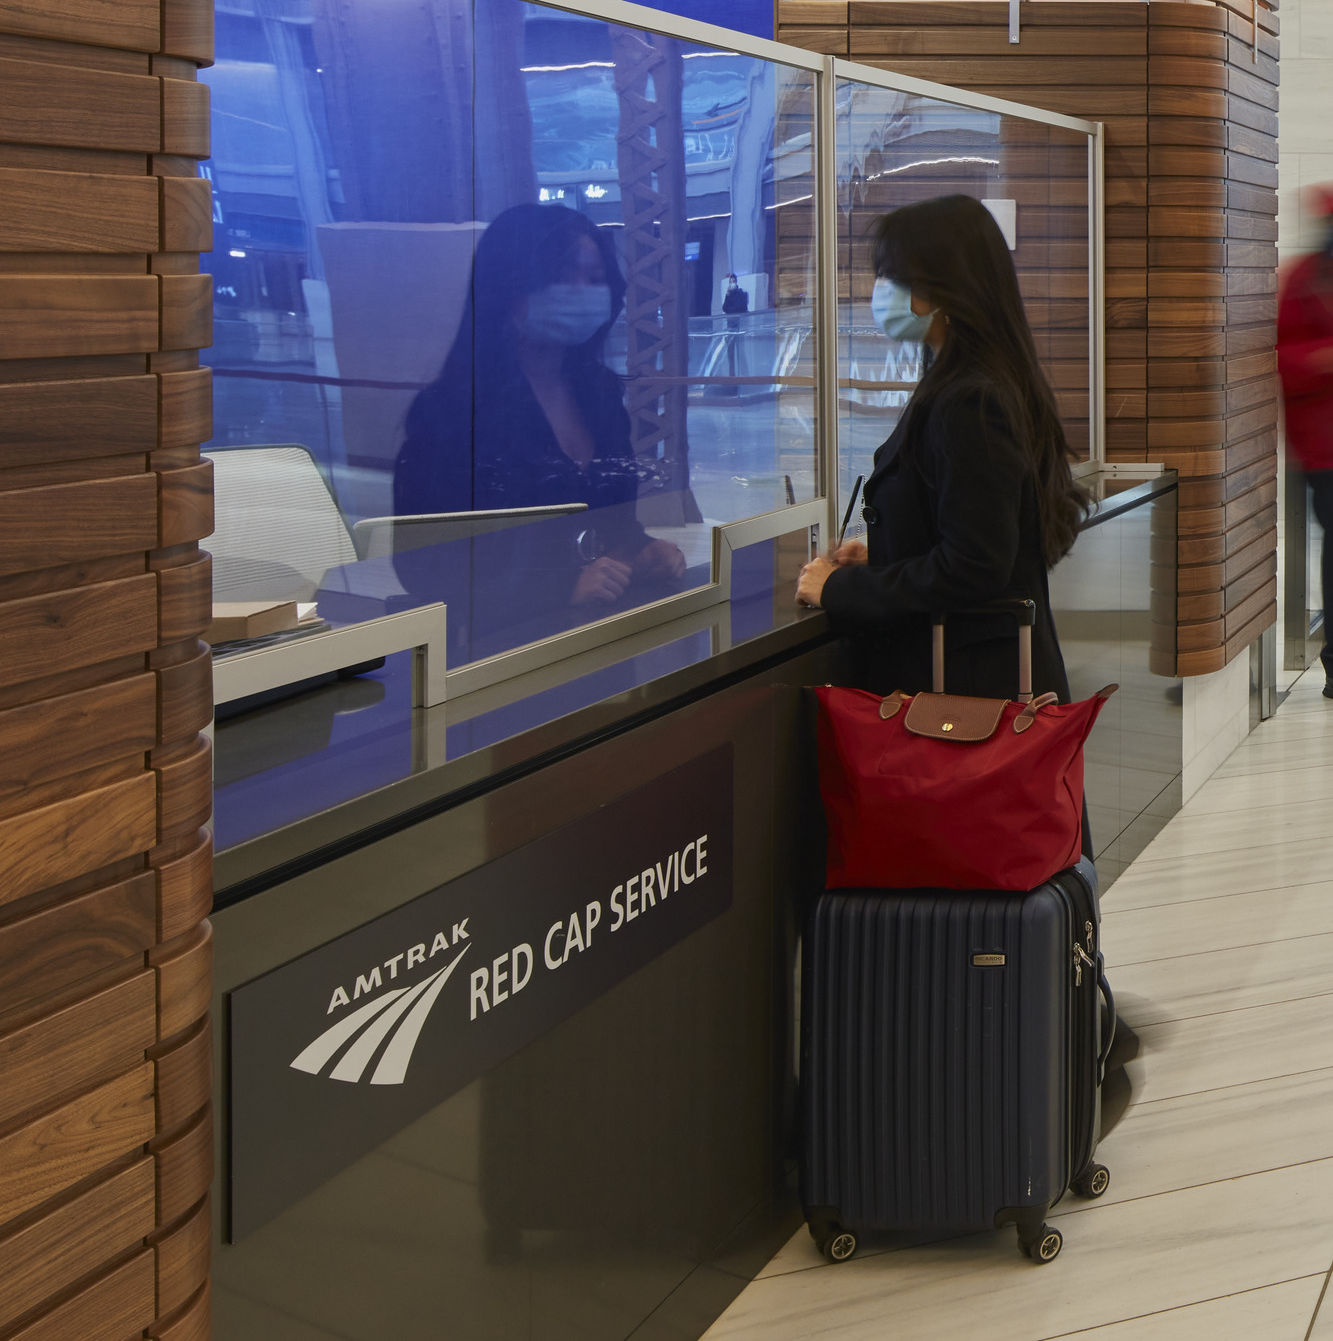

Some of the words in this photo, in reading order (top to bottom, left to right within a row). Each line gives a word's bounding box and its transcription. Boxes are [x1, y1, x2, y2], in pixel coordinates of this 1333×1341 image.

[327, 917, 470, 1015] AMTRAK
[470, 942, 533, 1021] RED
[543, 899, 602, 972] CAP
[610, 834, 709, 933] SERVICE
